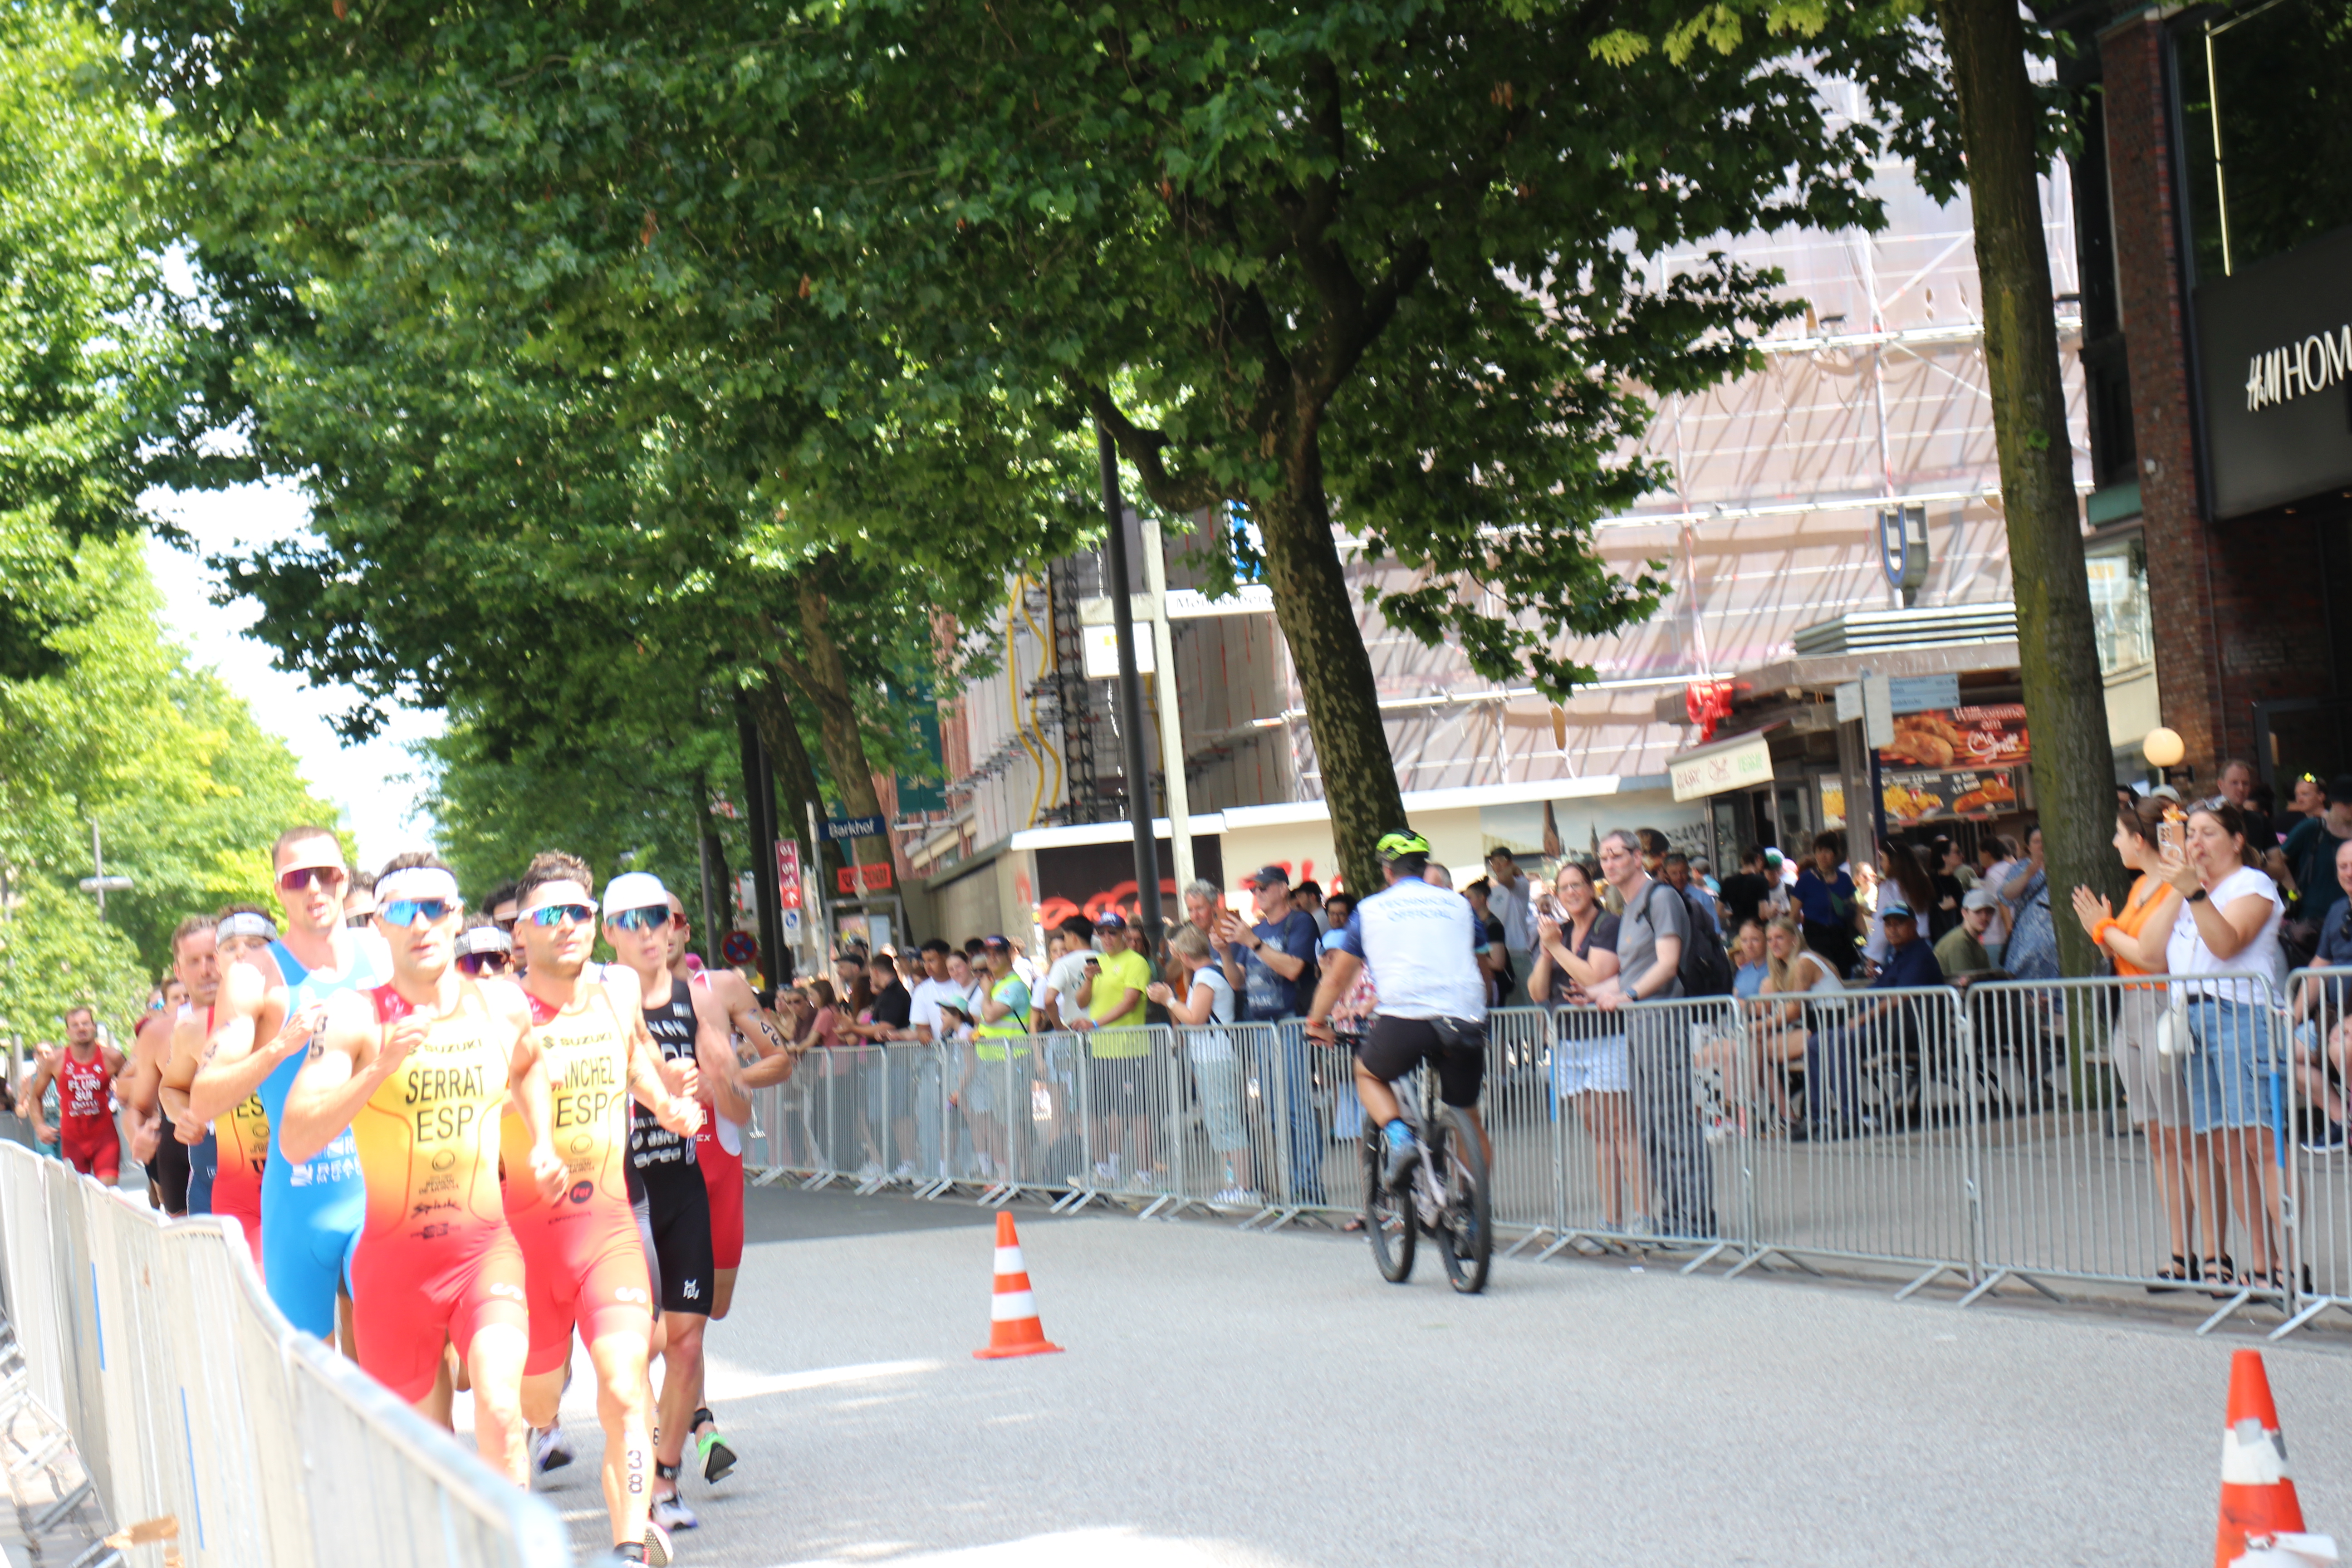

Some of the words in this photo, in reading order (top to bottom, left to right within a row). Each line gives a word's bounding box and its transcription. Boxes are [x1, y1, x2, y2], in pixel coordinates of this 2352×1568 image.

[2281, 322, 2352, 401] HOM
[828, 818, 875, 838] Barkhof
[1387, 908, 1455, 923] OFFICIAL
[560, 1032, 612, 1046] SUZUKI
[405, 1065, 482, 1105] SERRAT
[416, 1106, 474, 1142] ESP
[556, 1092, 608, 1129] ESP
